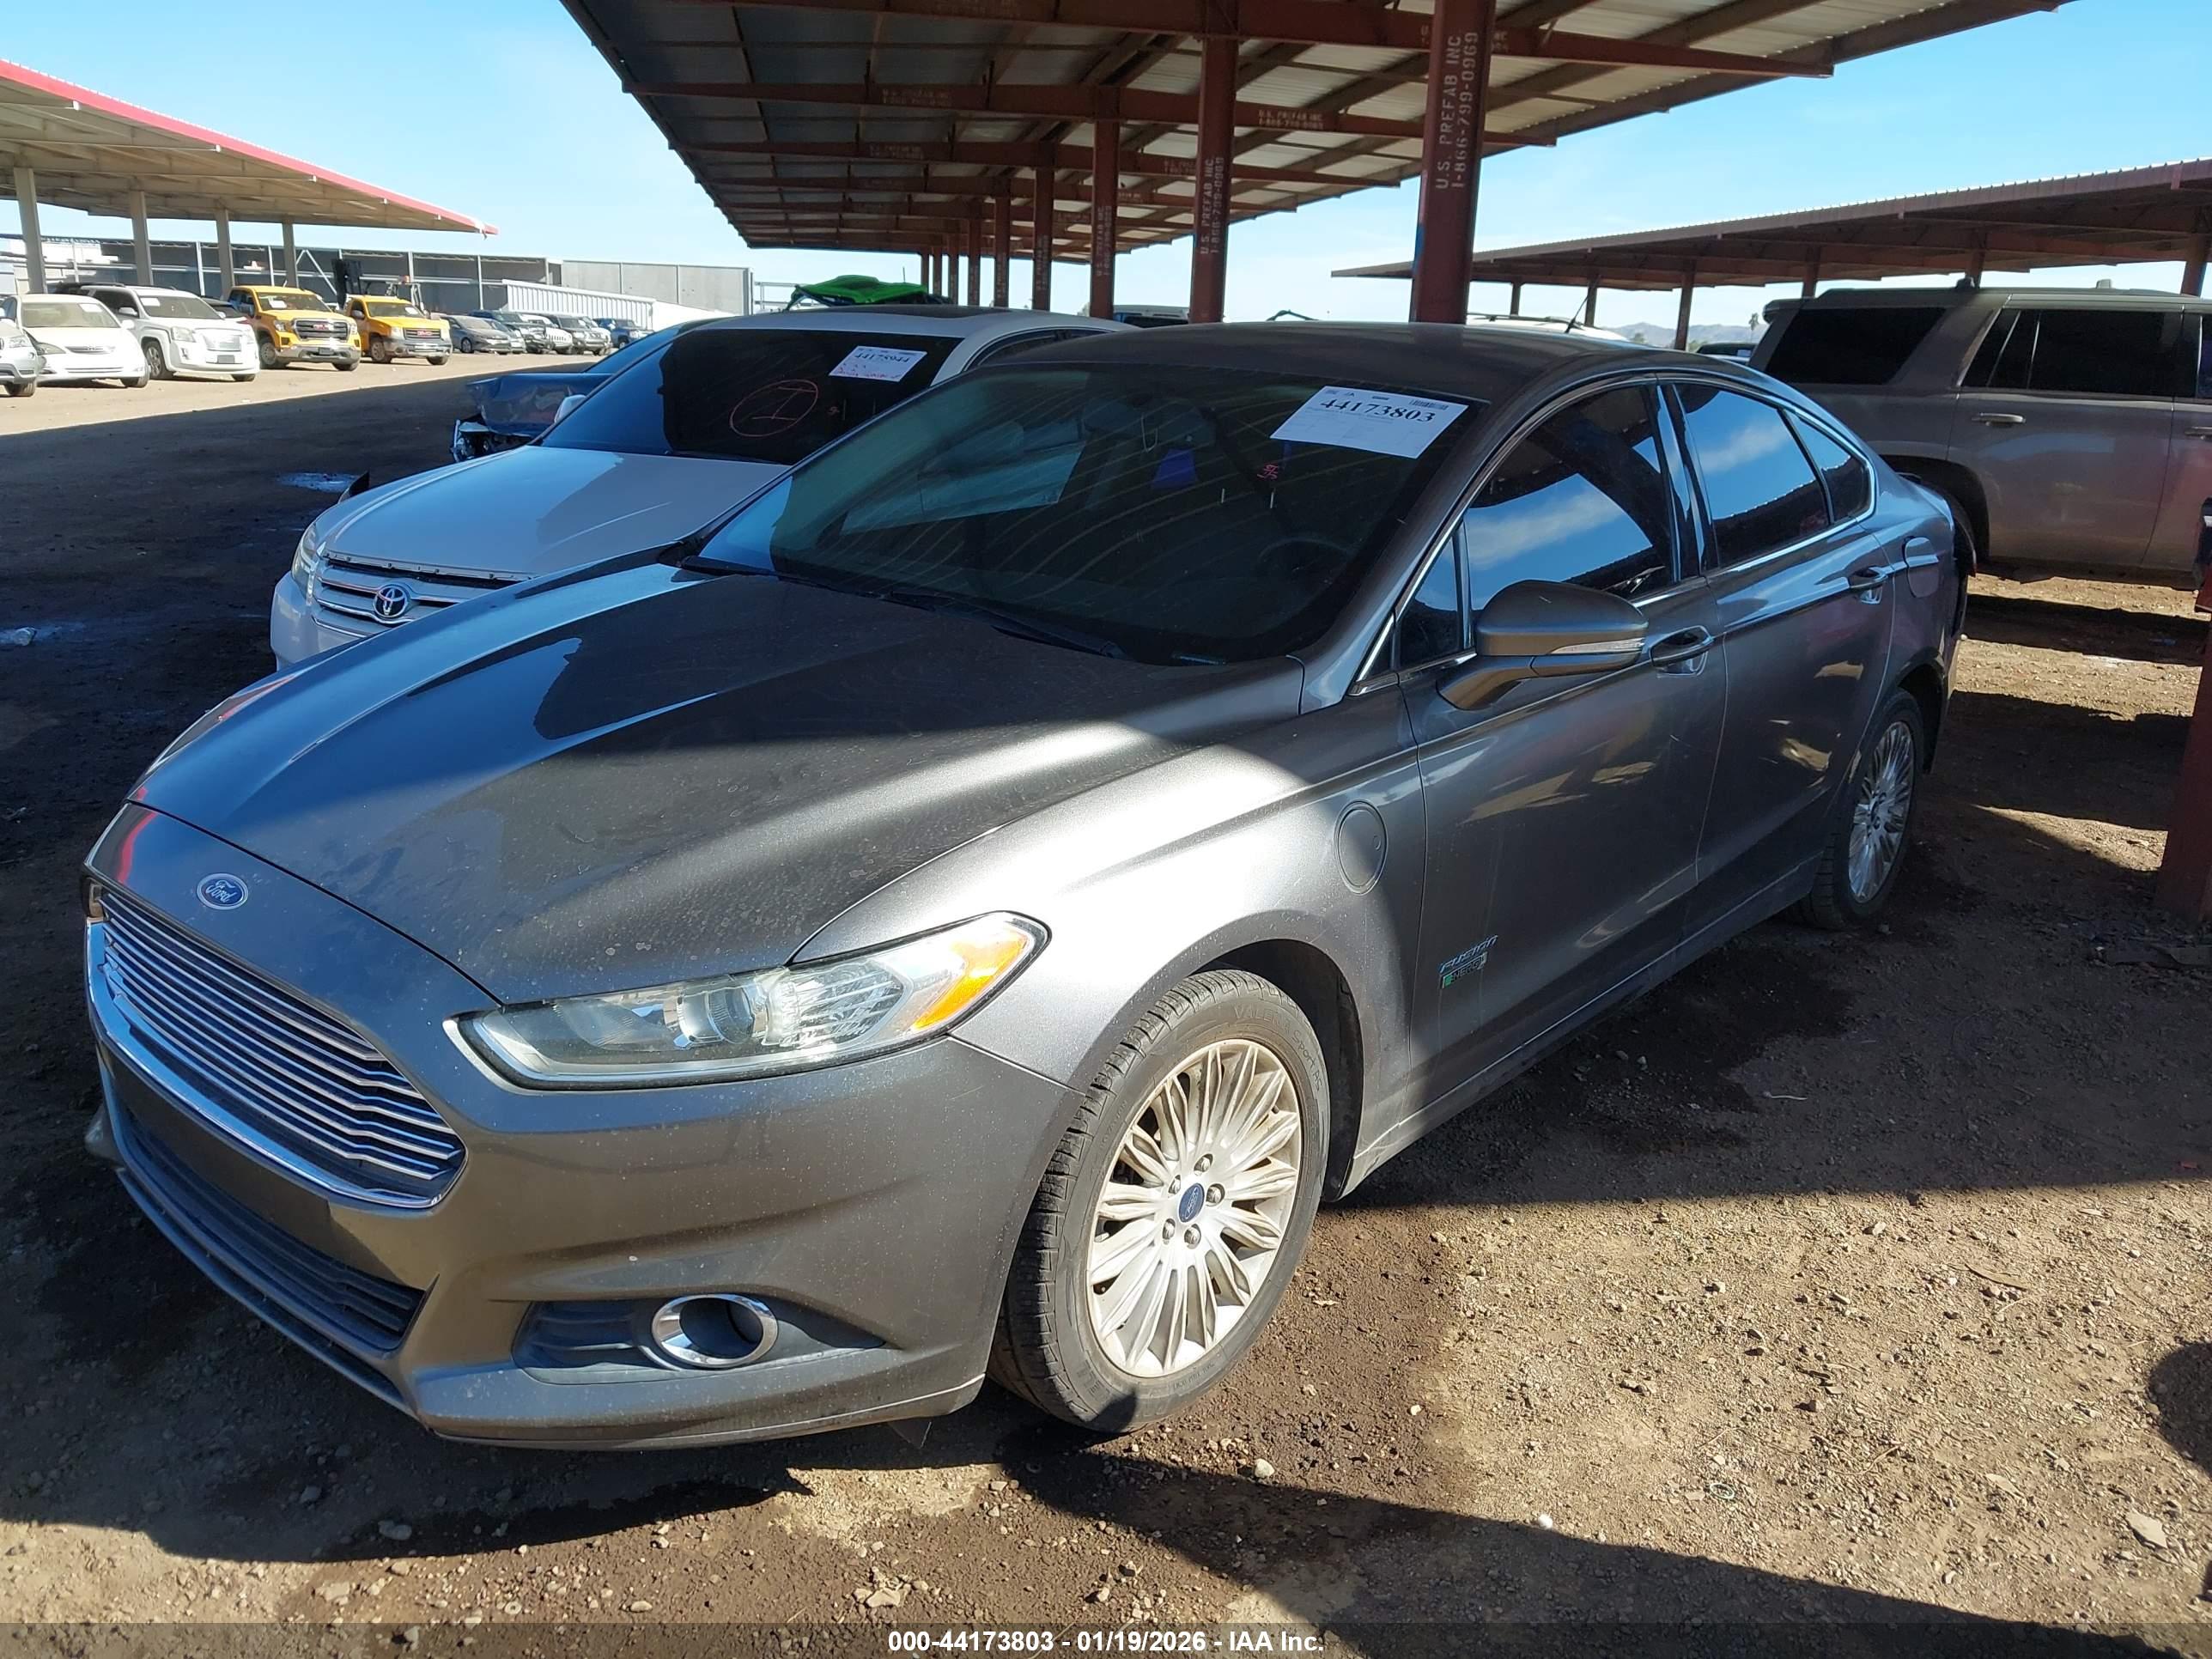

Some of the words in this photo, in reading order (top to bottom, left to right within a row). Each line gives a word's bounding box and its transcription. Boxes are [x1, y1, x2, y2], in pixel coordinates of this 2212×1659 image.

[1445, 34, 1462, 65] INC
[1439, 74, 1458, 145] PREFAB
[1450, 32, 1479, 190] 1-866-799-0969
[1204, 158, 1214, 178] INC
[1435, 155, 1452, 190] U.S.
[1201, 182, 1212, 227] PREFAB
[1320, 398, 1437, 423] 44173803
[205, 879, 238, 903] Ford
